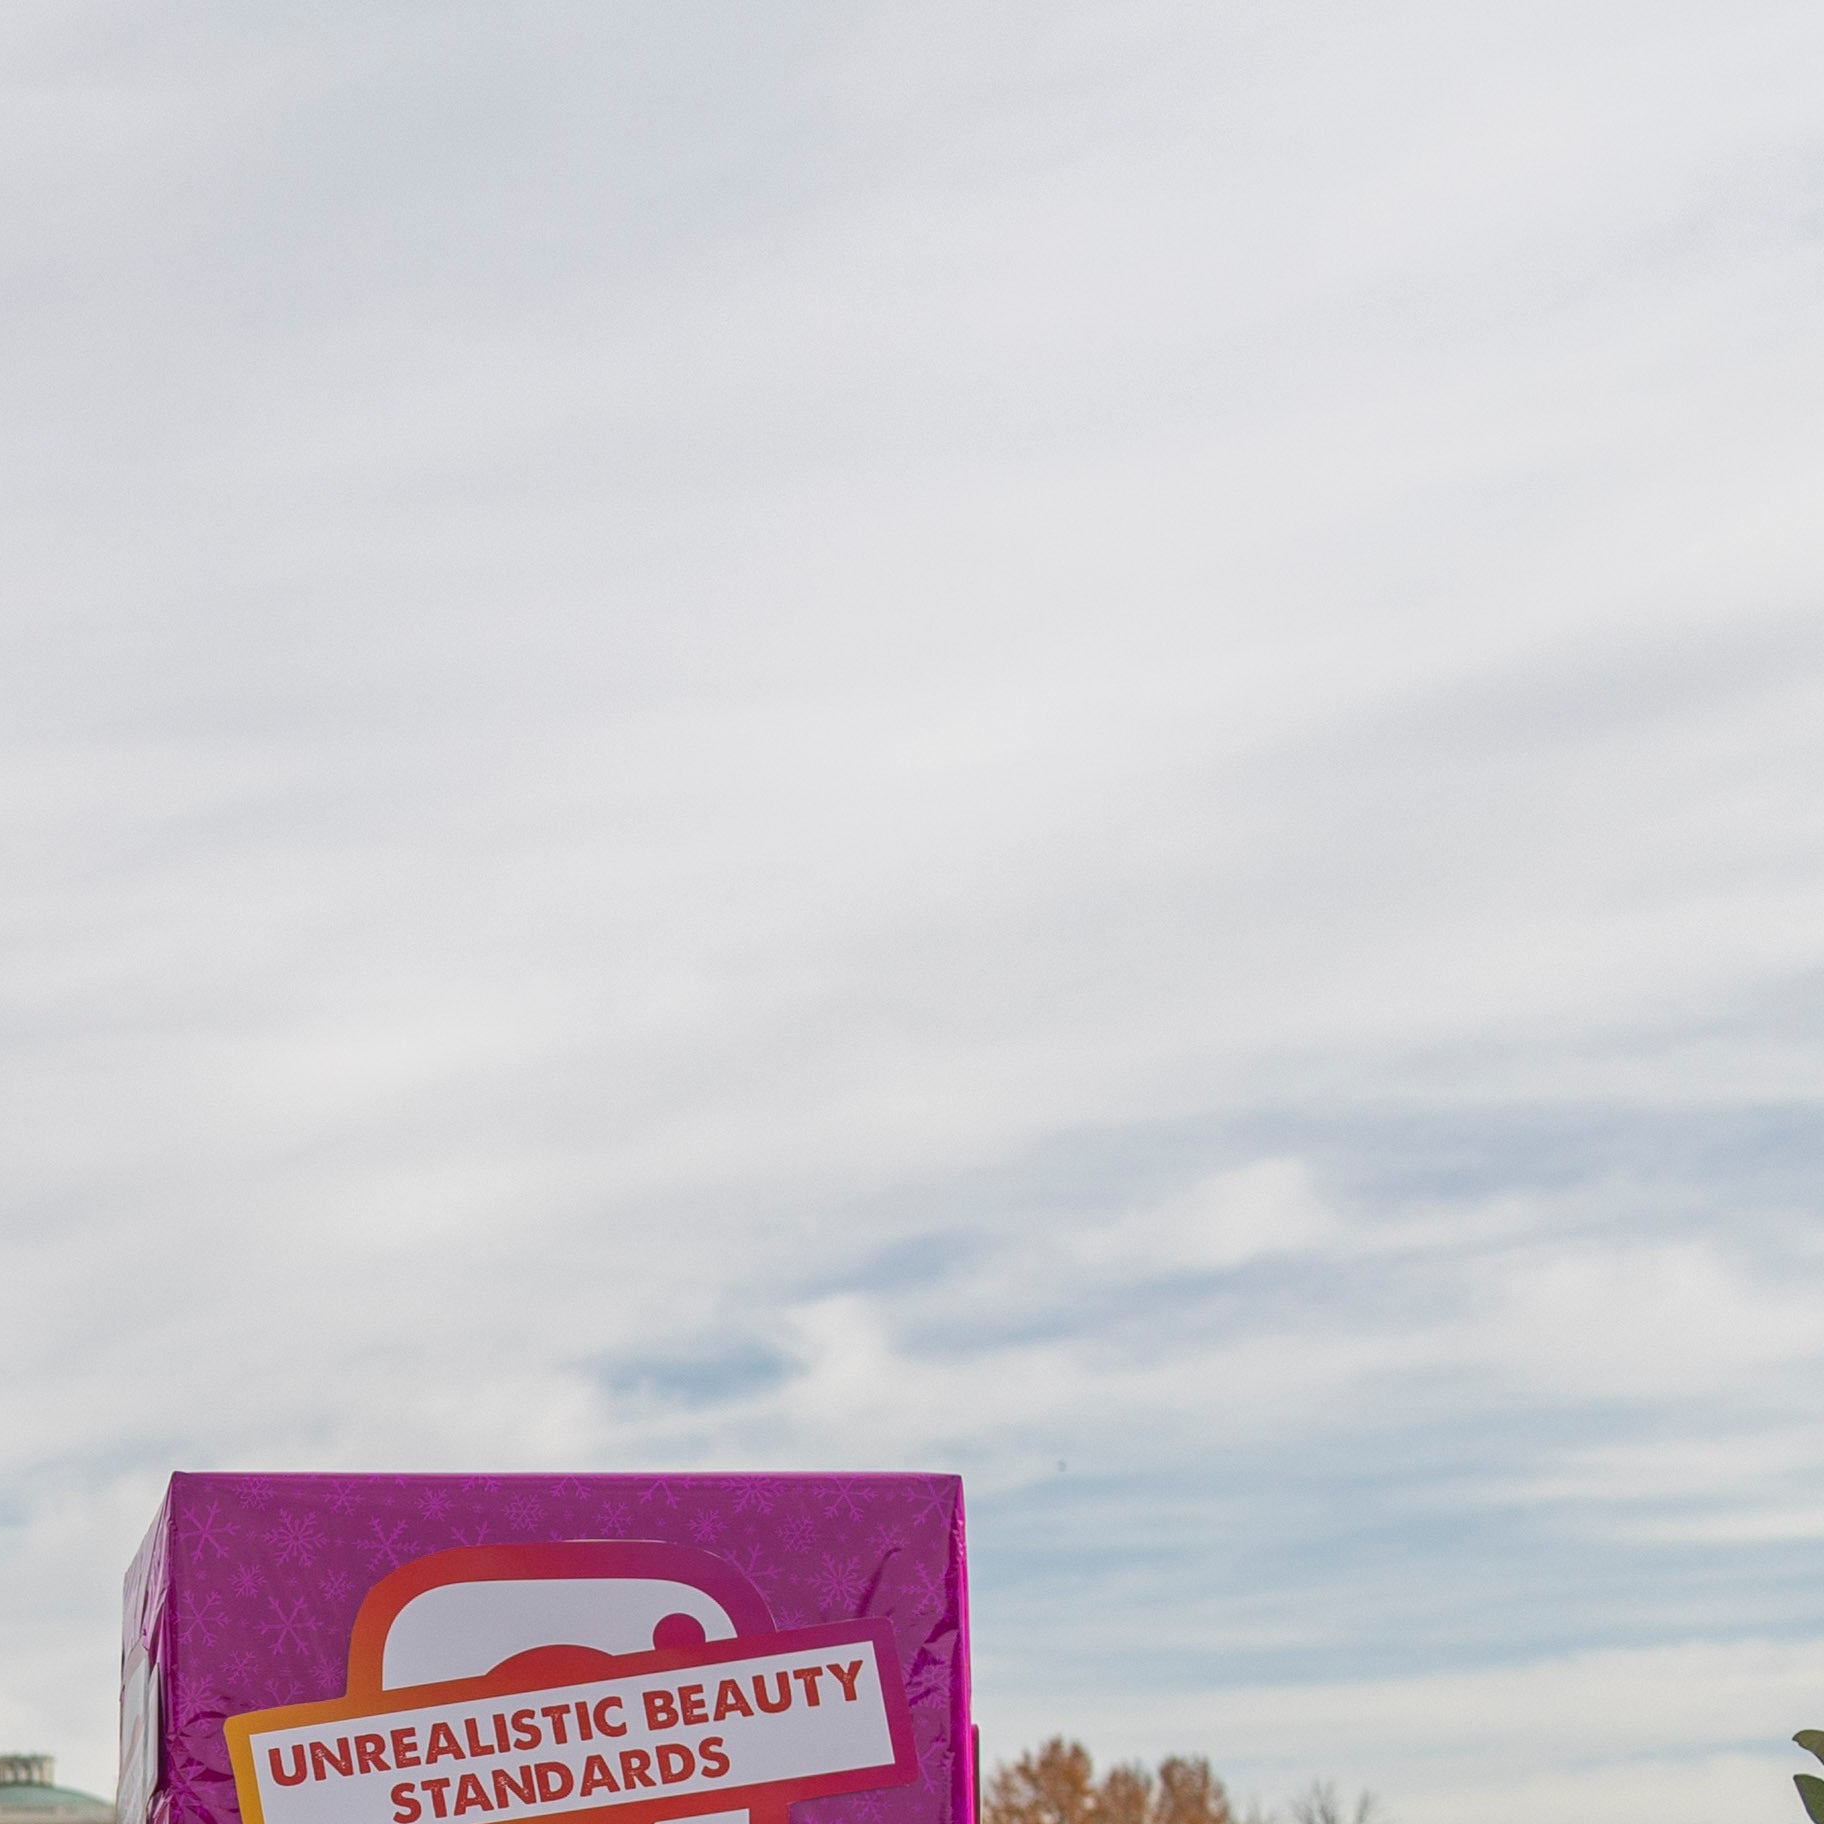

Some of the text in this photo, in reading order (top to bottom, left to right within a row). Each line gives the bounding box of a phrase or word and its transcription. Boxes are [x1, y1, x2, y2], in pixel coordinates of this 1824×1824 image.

[270, 1662, 860, 1785] UNREALISTIC BEAUTY
[393, 1739, 727, 1823] STANDARDS
